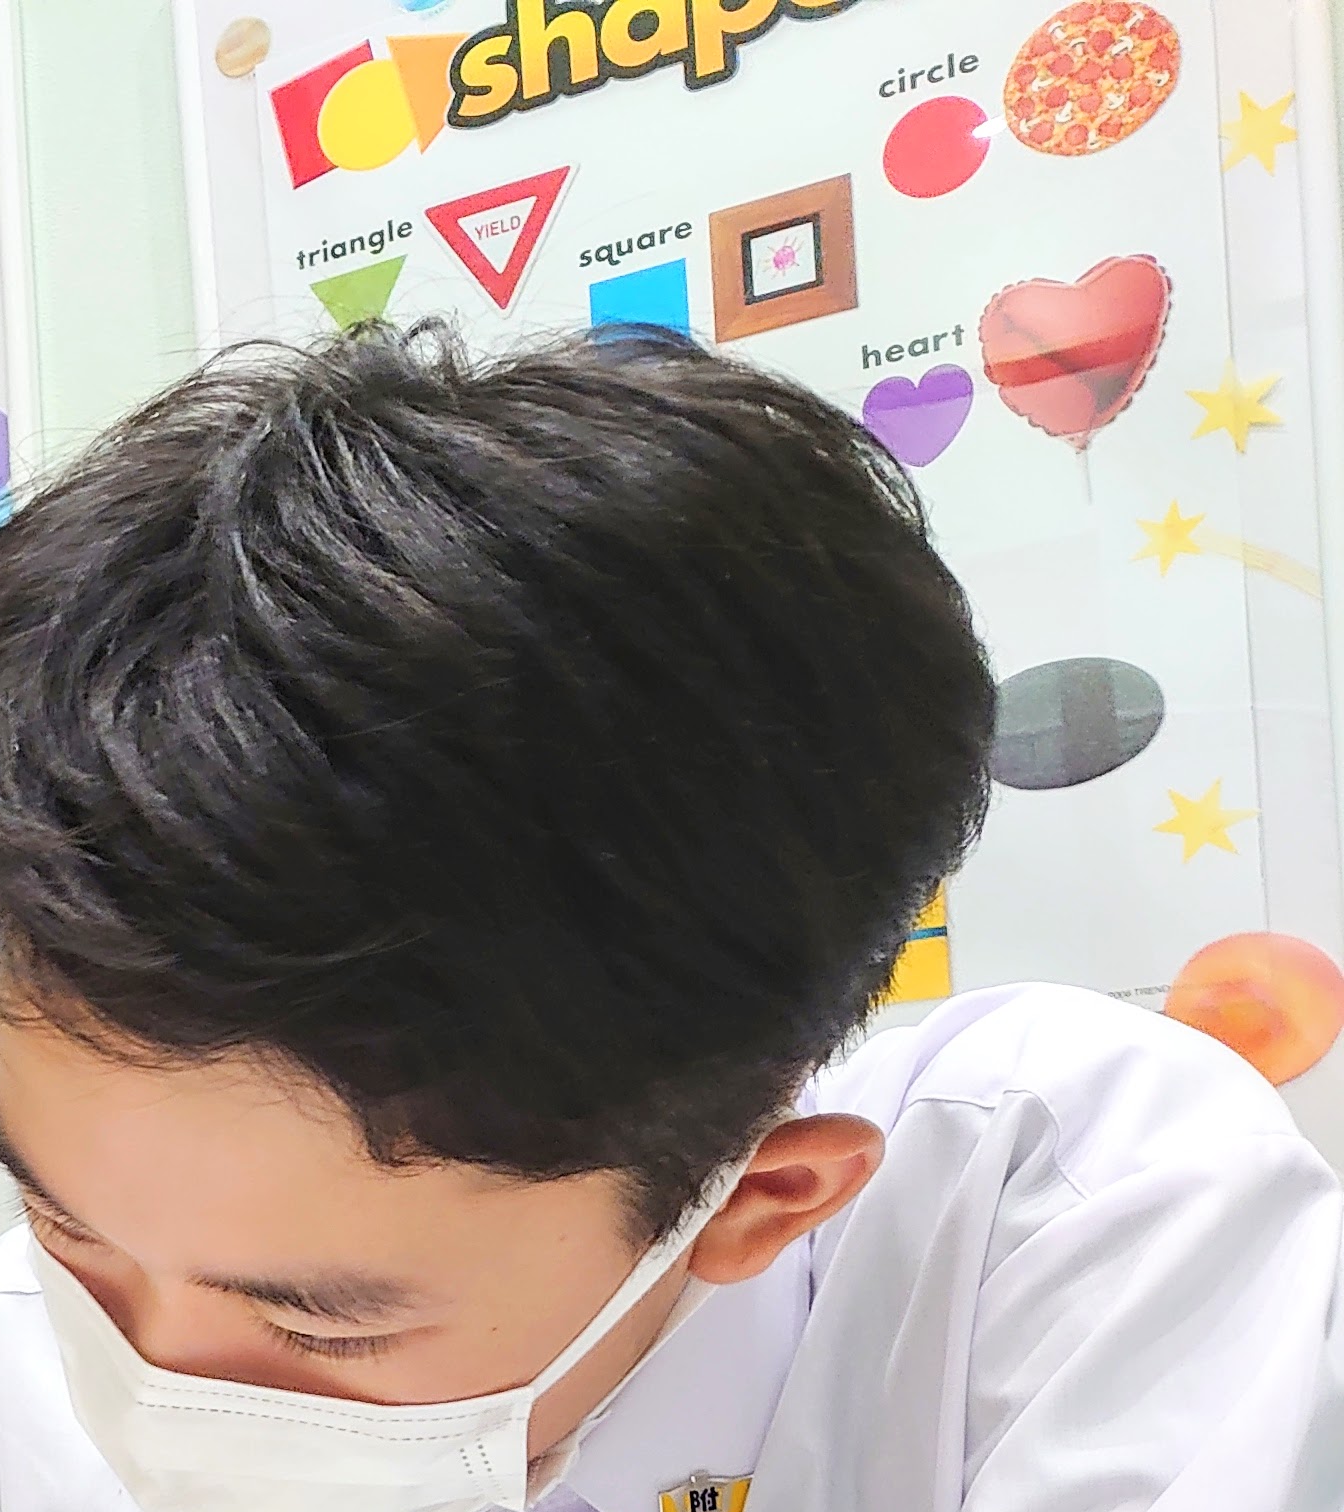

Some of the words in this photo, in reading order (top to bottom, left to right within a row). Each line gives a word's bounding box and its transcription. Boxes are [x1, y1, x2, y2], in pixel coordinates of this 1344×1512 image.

[449, 0, 854, 127] shap
[879, 54, 978, 97] circle
[296, 219, 413, 271] triangle
[475, 212, 522, 241] YIELD
[579, 221, 693, 270] square
[862, 325, 968, 375] heart
